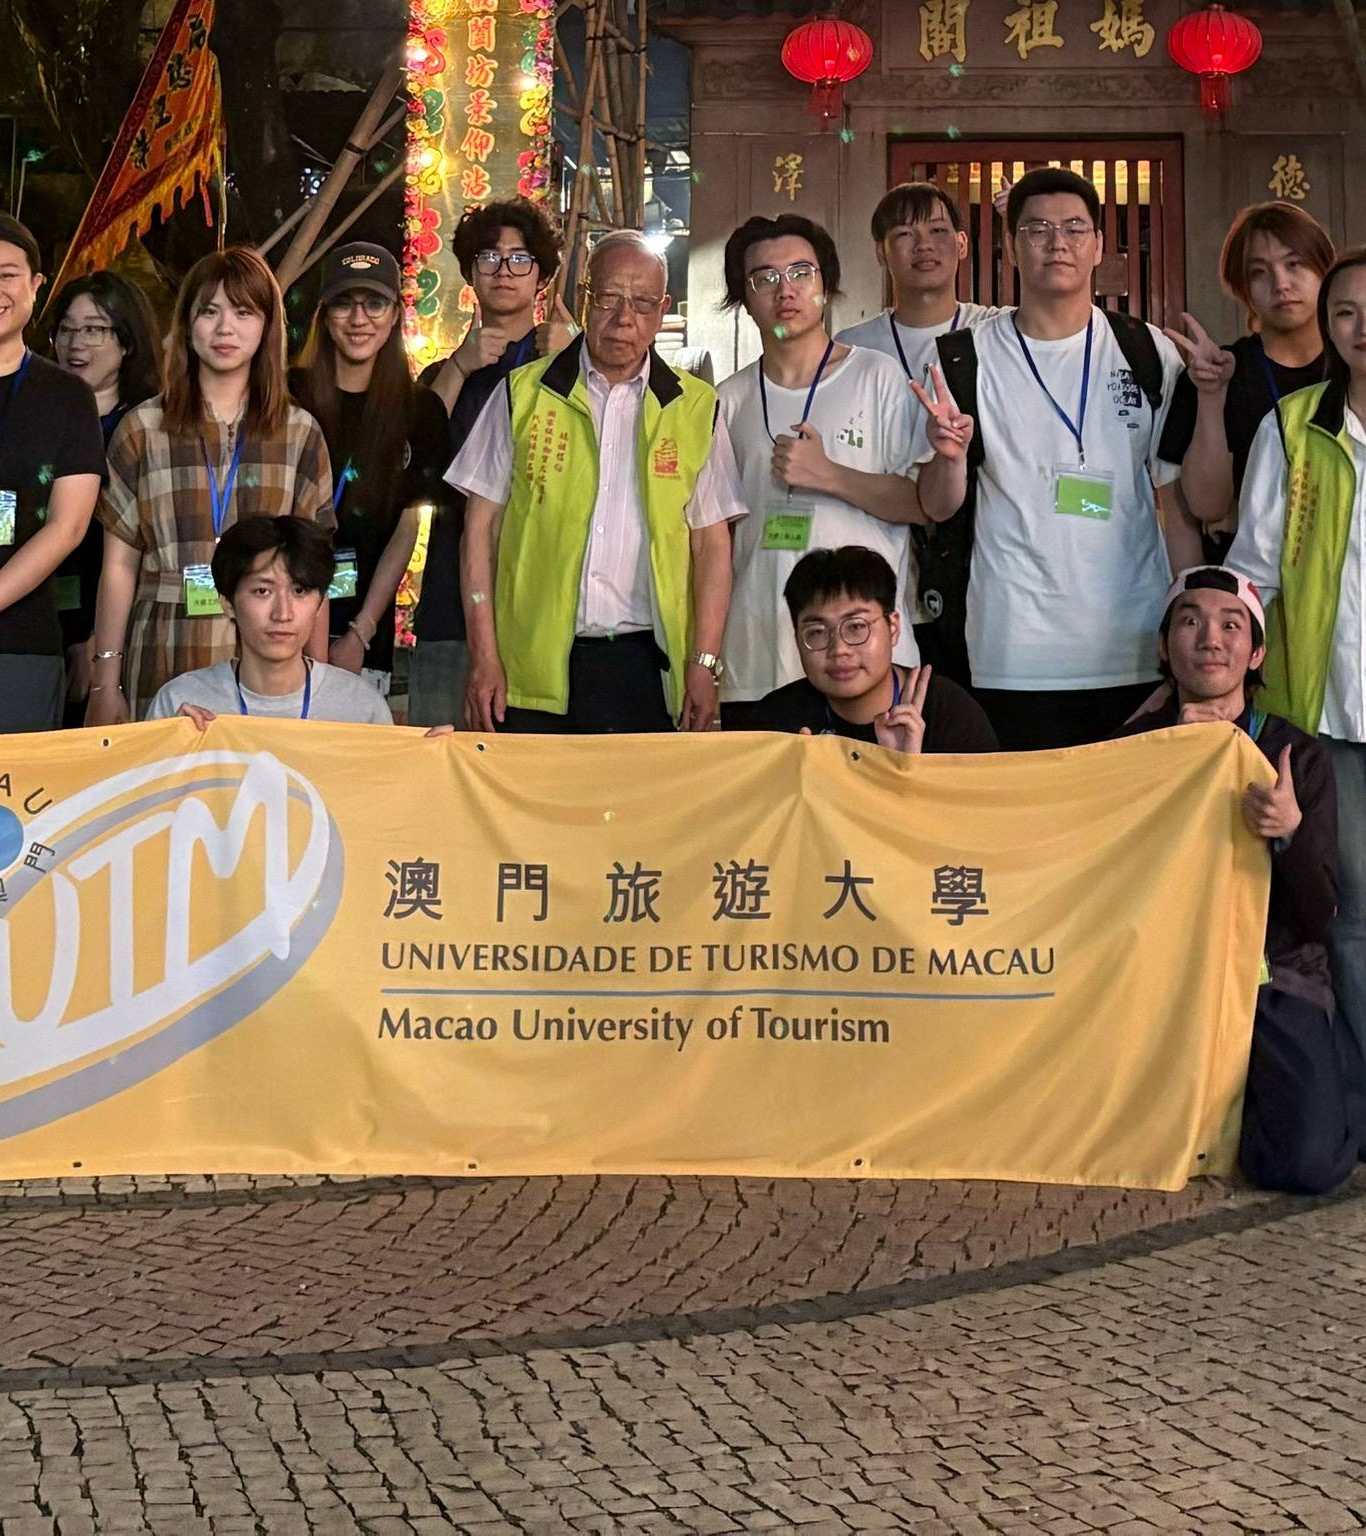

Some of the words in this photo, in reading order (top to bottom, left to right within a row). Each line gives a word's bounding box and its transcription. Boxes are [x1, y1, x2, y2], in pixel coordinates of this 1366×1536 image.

[383, 856, 989, 926] 澳門旅遊大學
[382, 942, 636, 973] UNIVERSIDADE
[650, 945, 692, 972] DE
[701, 943, 859, 973] TURISMO
[872, 946, 915, 974] DE
[928, 947, 1055, 976] MACAU
[378, 1007, 498, 1041] Macao
[513, 1007, 694, 1052] University
[706, 1005, 743, 1040] of
[750, 1007, 890, 1043] Tourism
